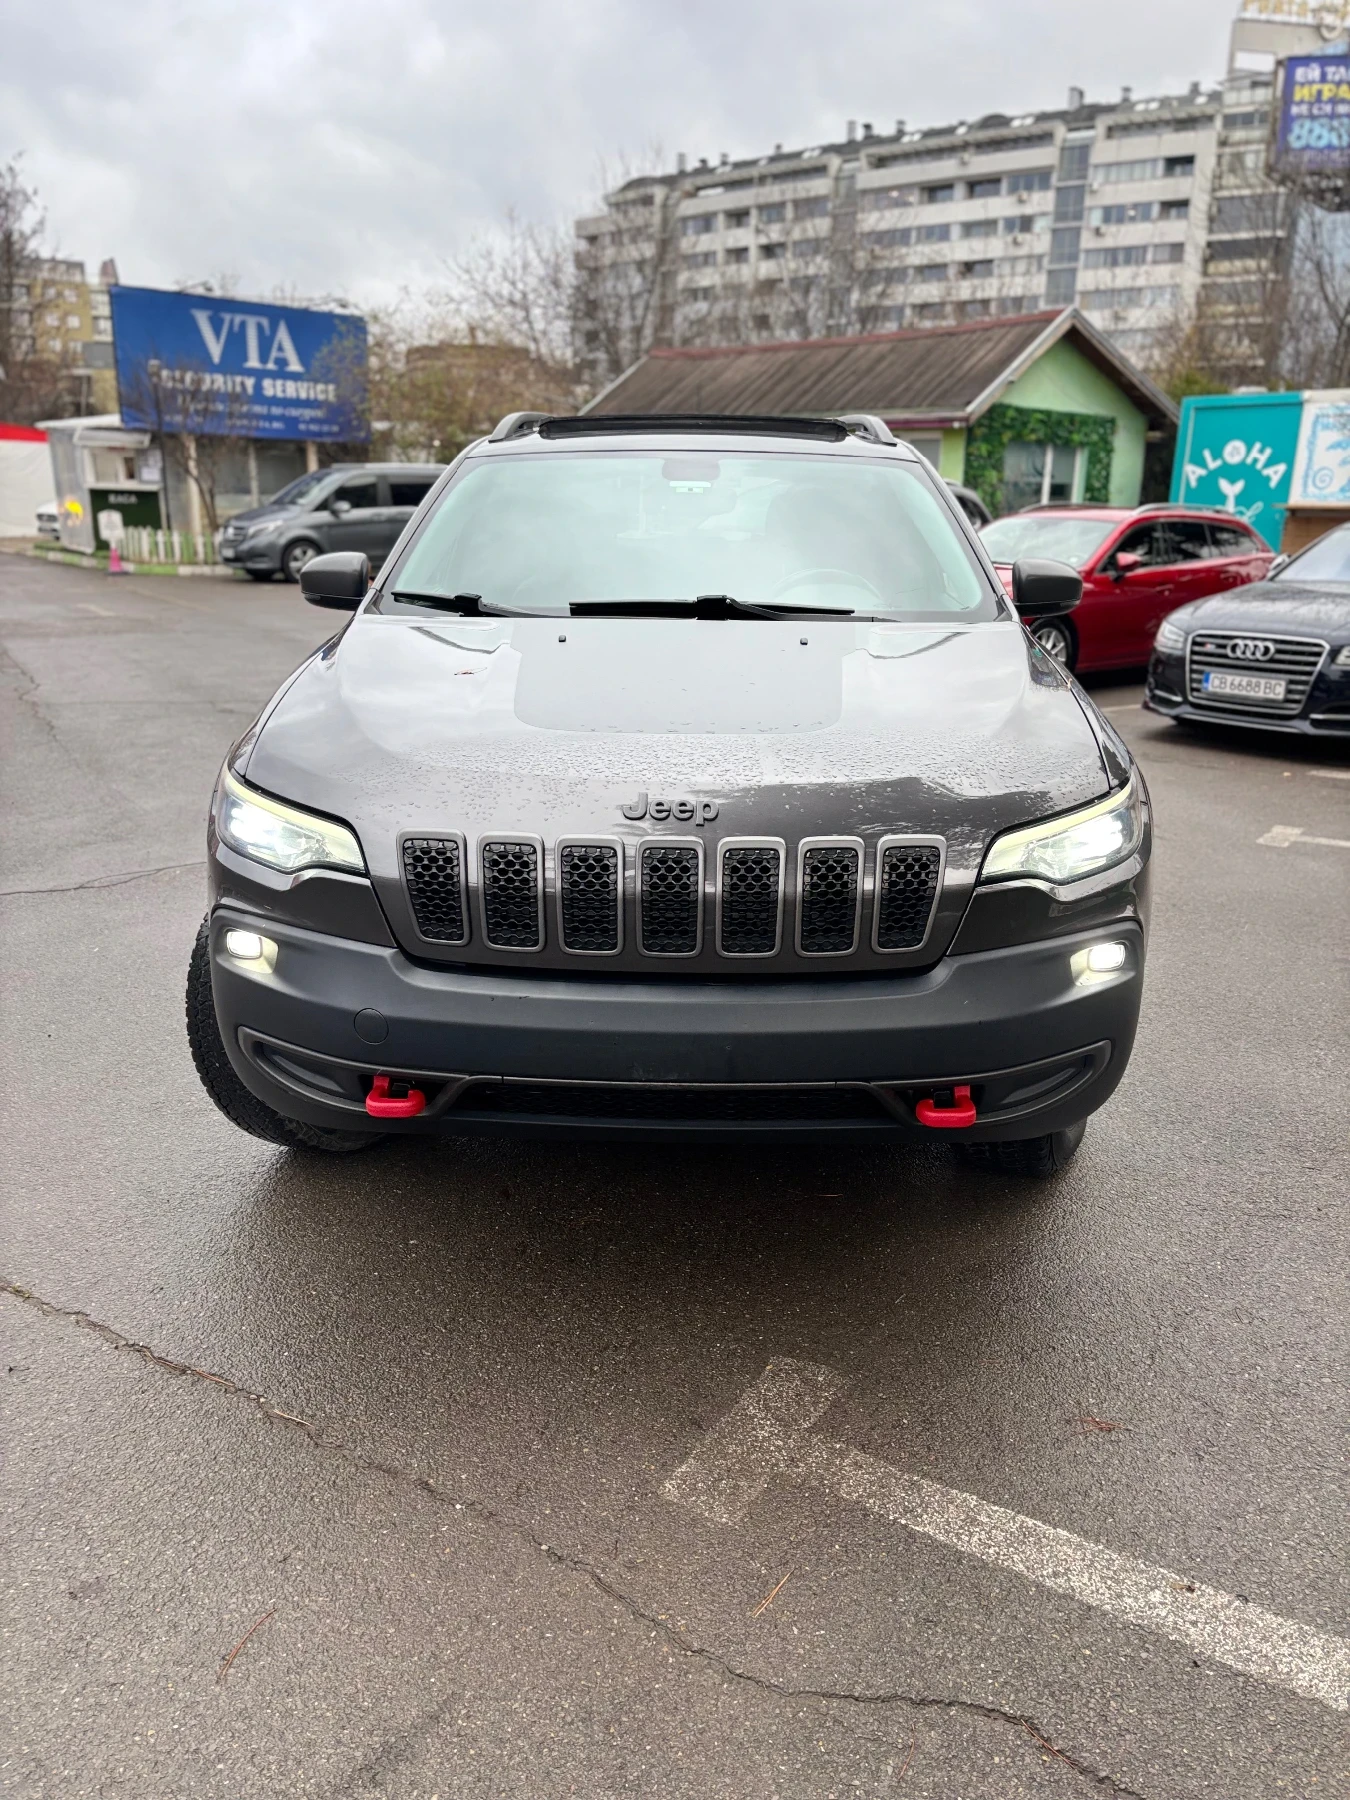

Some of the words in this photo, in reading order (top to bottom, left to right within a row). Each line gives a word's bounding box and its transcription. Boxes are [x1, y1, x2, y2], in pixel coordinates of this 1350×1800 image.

[190, 309, 305, 373] VTA
[262, 377, 337, 402] SERVICE
[1184, 439, 1287, 490] ALOHA
[1229, 677, 1262, 694] 6688
[622, 792, 719, 827] Jeep
